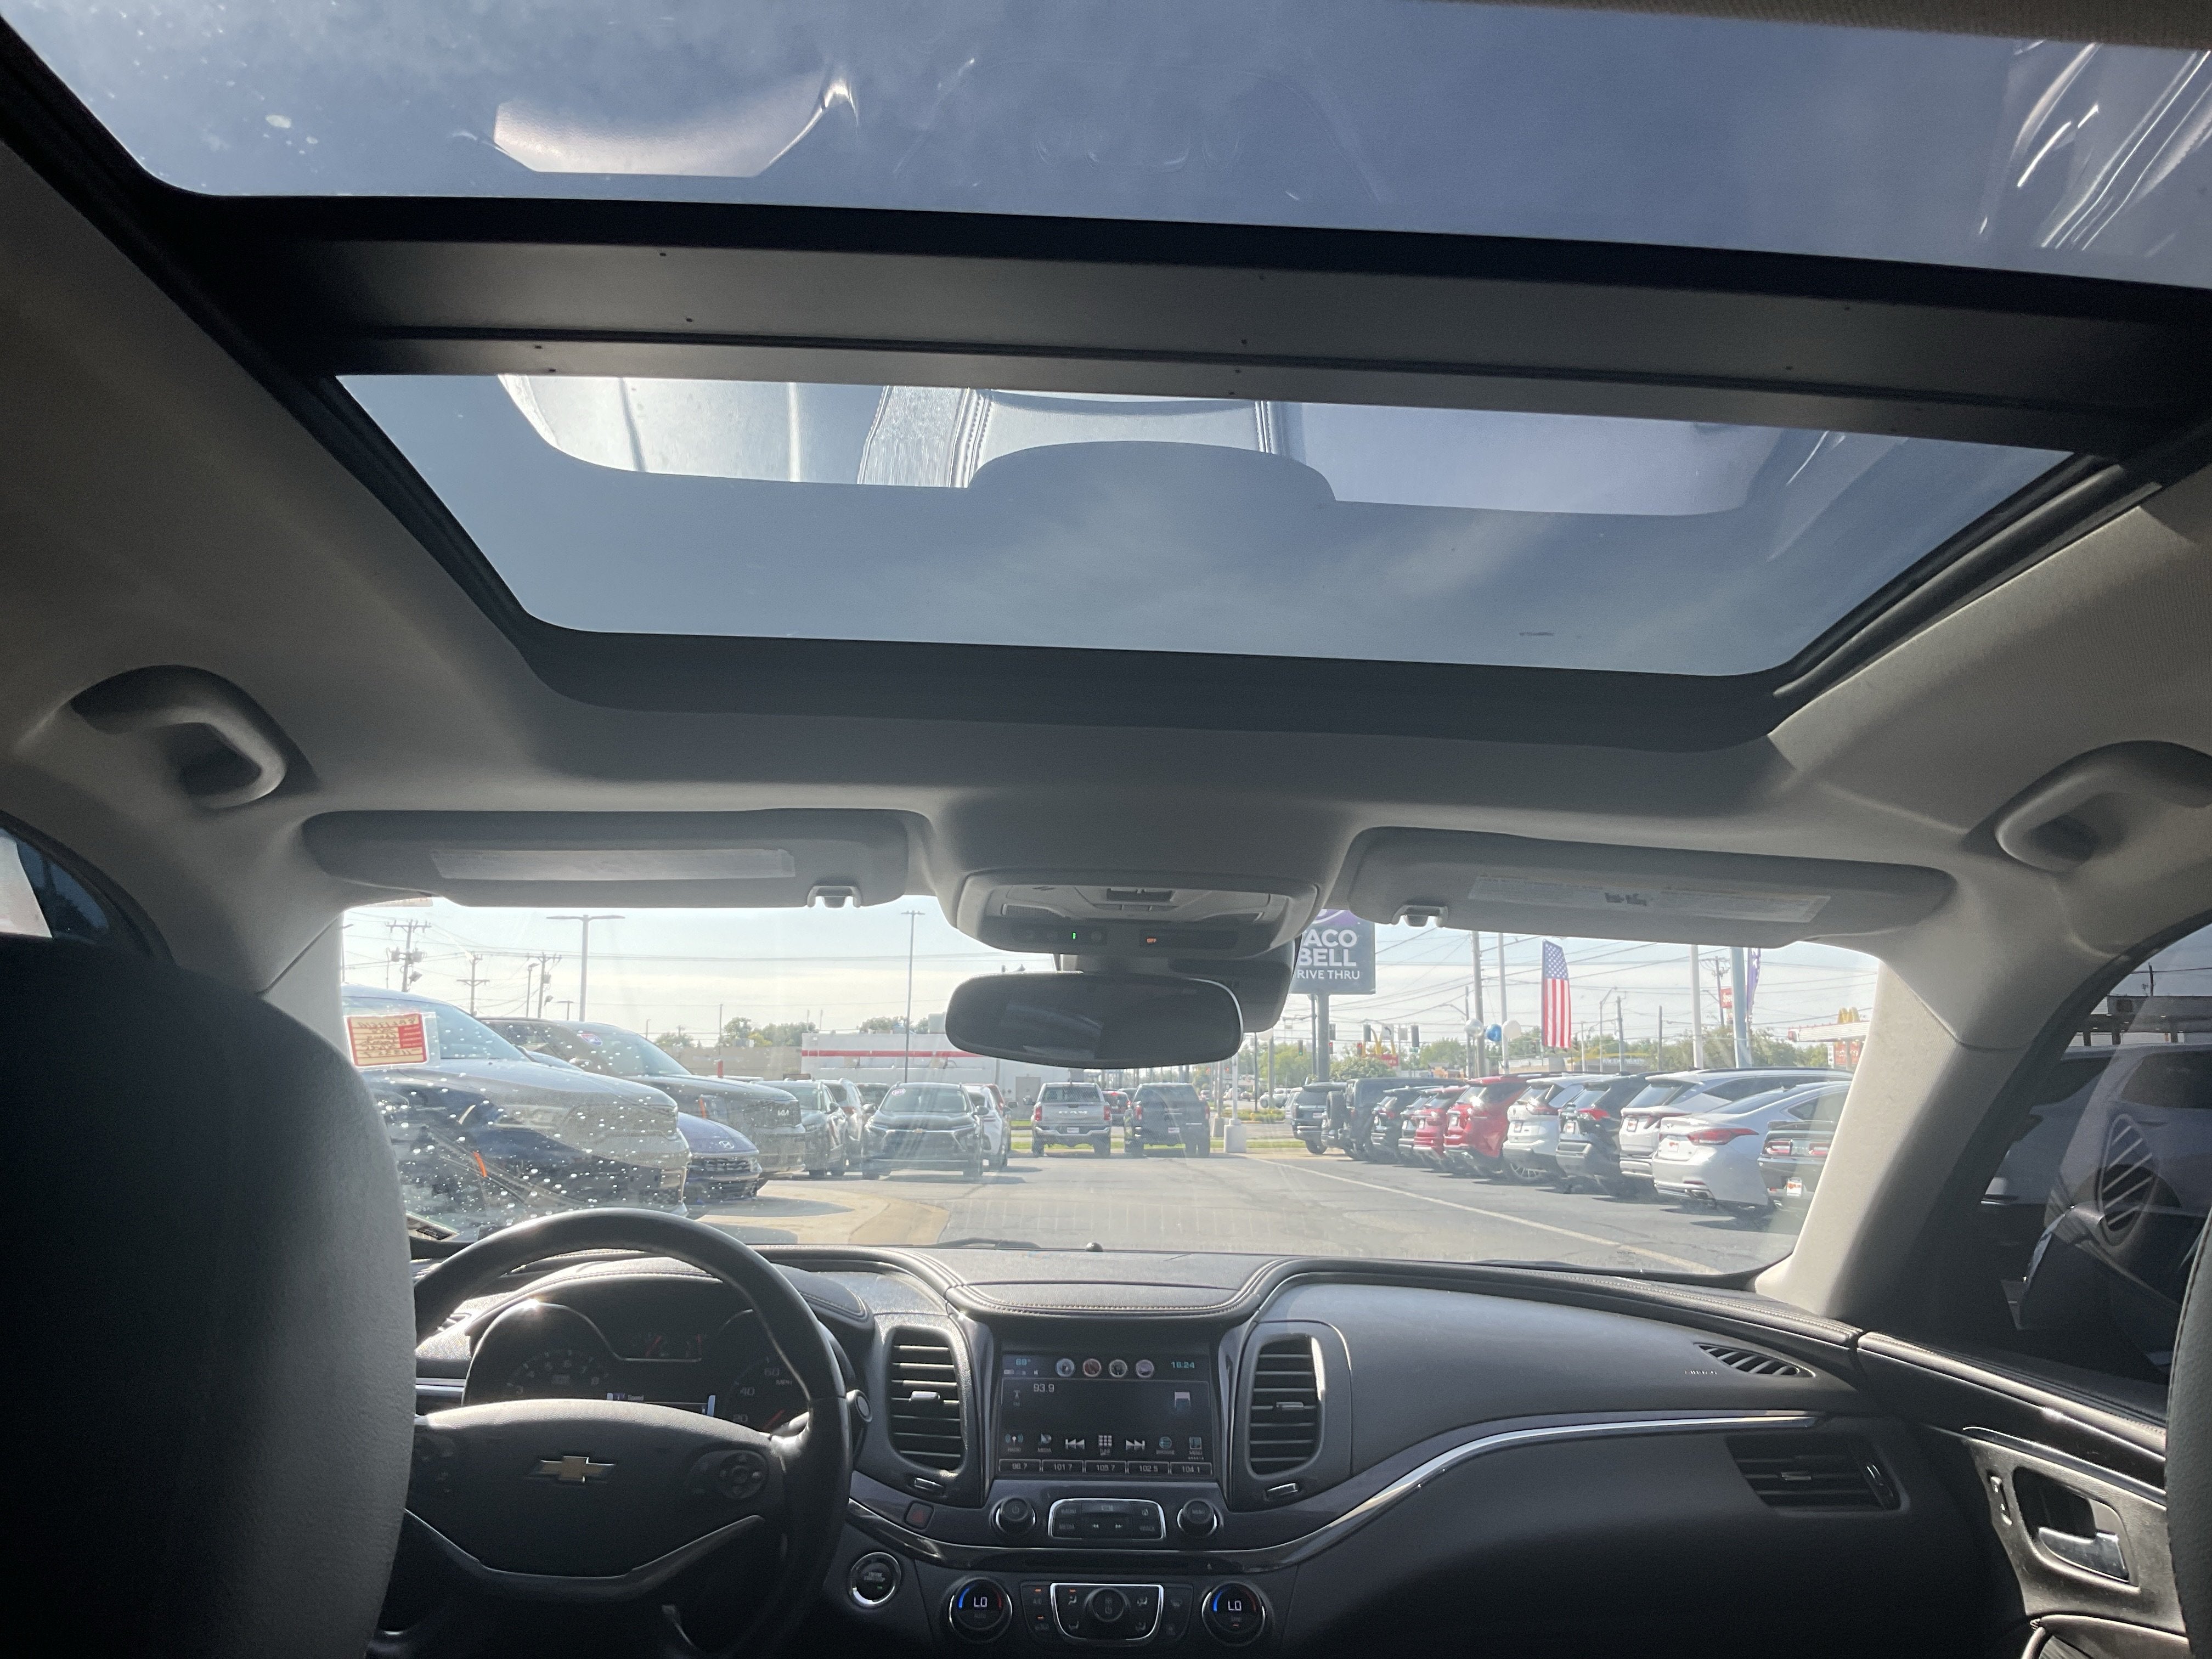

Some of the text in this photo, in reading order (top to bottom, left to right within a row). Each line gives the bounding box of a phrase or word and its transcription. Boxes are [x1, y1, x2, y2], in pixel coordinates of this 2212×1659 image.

[1302, 929, 1358, 947] ACO
[1296, 948, 1357, 967] BELL
[1295, 970, 1361, 980] RIVE THRU
[740, 1387, 755, 1396] 40
[1033, 1384, 1054, 1392] 93.9
[732, 1414, 748, 1423] 20
